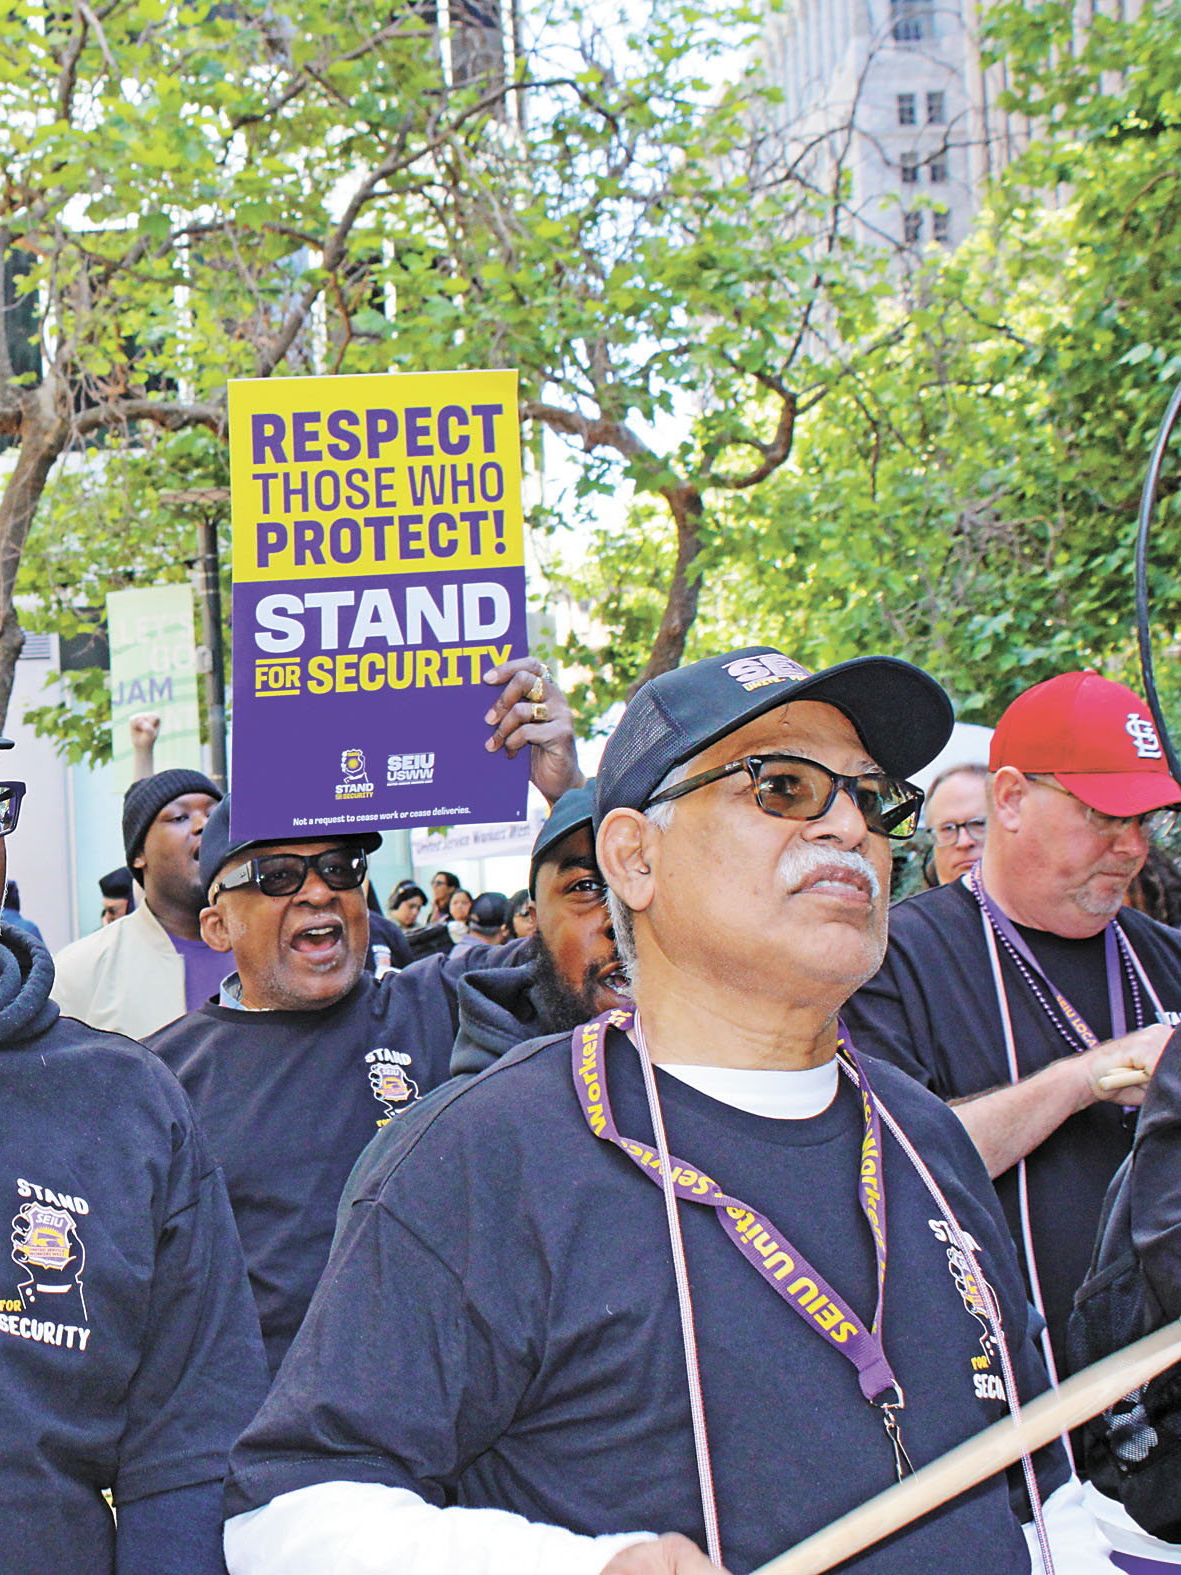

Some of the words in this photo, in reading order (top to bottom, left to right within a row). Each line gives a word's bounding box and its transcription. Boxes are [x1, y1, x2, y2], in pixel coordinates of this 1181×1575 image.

[251, 404, 504, 465] RESPECT
[252, 467, 397, 515] THOSE
[407, 461, 504, 506] WHO
[256, 510, 506, 568] PROTECT!
[254, 582, 511, 653] STAND
[112, 676, 173, 706] JAM
[254, 665, 301, 689] FOR
[387, 753, 435, 771] SEIU
[387, 768, 434, 782] USWW
[335, 783, 374, 793] STAND
[293, 817, 307, 826] Not
[315, 815, 345, 827] request
[346, 814, 355, 823] to
[357, 813, 379, 822] cease
[380, 811, 399, 820] work
[400, 811, 409, 819] or
[410, 809, 431, 818] cease
[432, 806, 471, 817] deliveries.
[1072, 1018, 1097, 1048] LOCA
[365, 1048, 412, 1066] STAND
[579, 1022, 607, 1137] Workers
[17, 1178, 90, 1215] STAND
[35, 1213, 64, 1228] SEIU
[724, 1205, 795, 1280] Unite
[786, 1276, 859, 1343] SEIU
[971, 1356, 989, 1371] FOR
